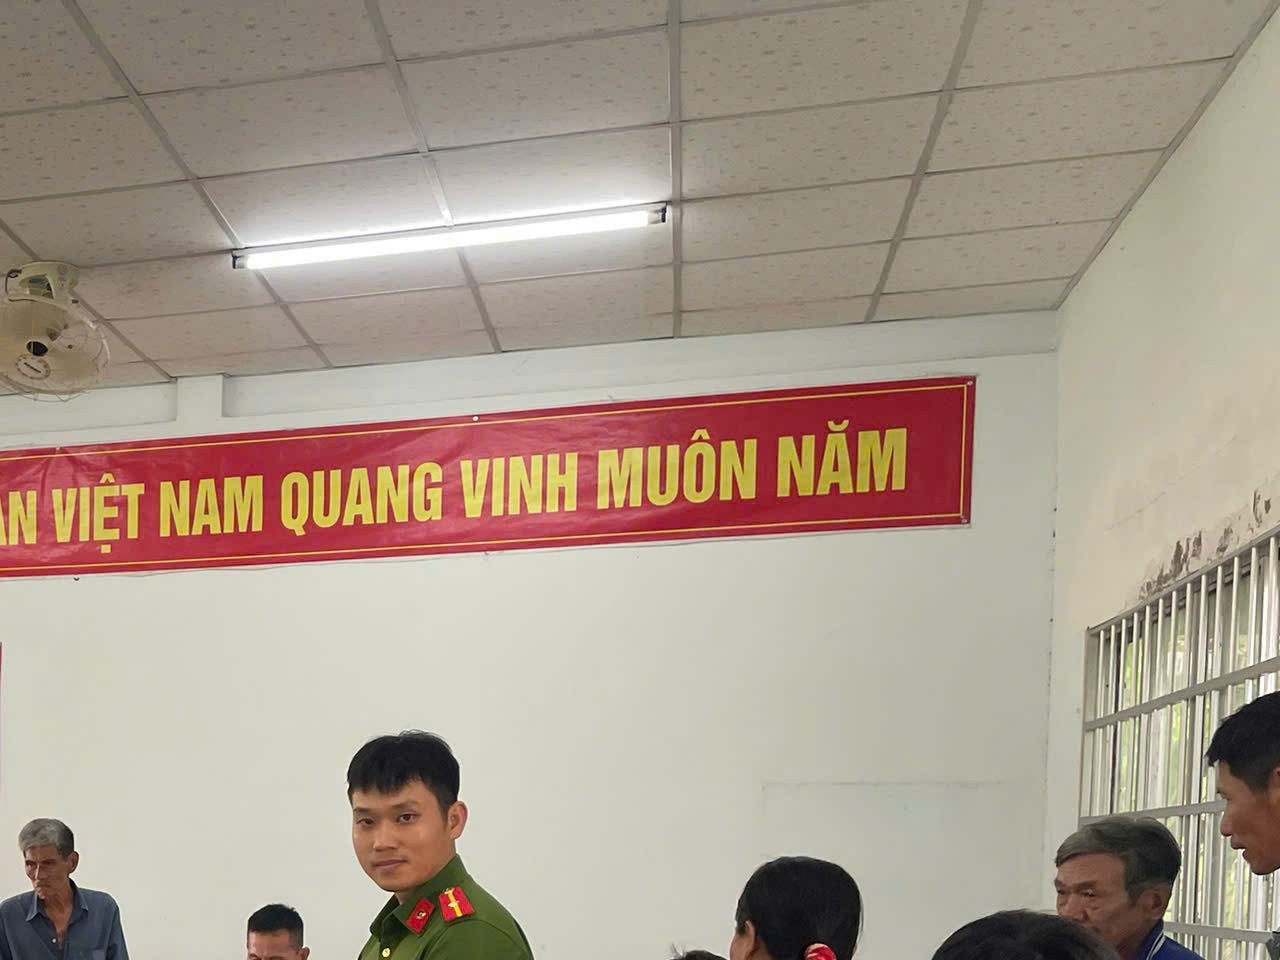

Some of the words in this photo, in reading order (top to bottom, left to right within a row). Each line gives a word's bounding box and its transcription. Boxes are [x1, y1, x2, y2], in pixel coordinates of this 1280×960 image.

[51, 472, 145, 554] VIỆT
[159, 475, 264, 538] NAM
[280, 461, 444, 537] QUANG
[459, 451, 579, 518] VINH
[596, 428, 757, 509] MUÔN
[776, 419, 907, 497] NĂM
